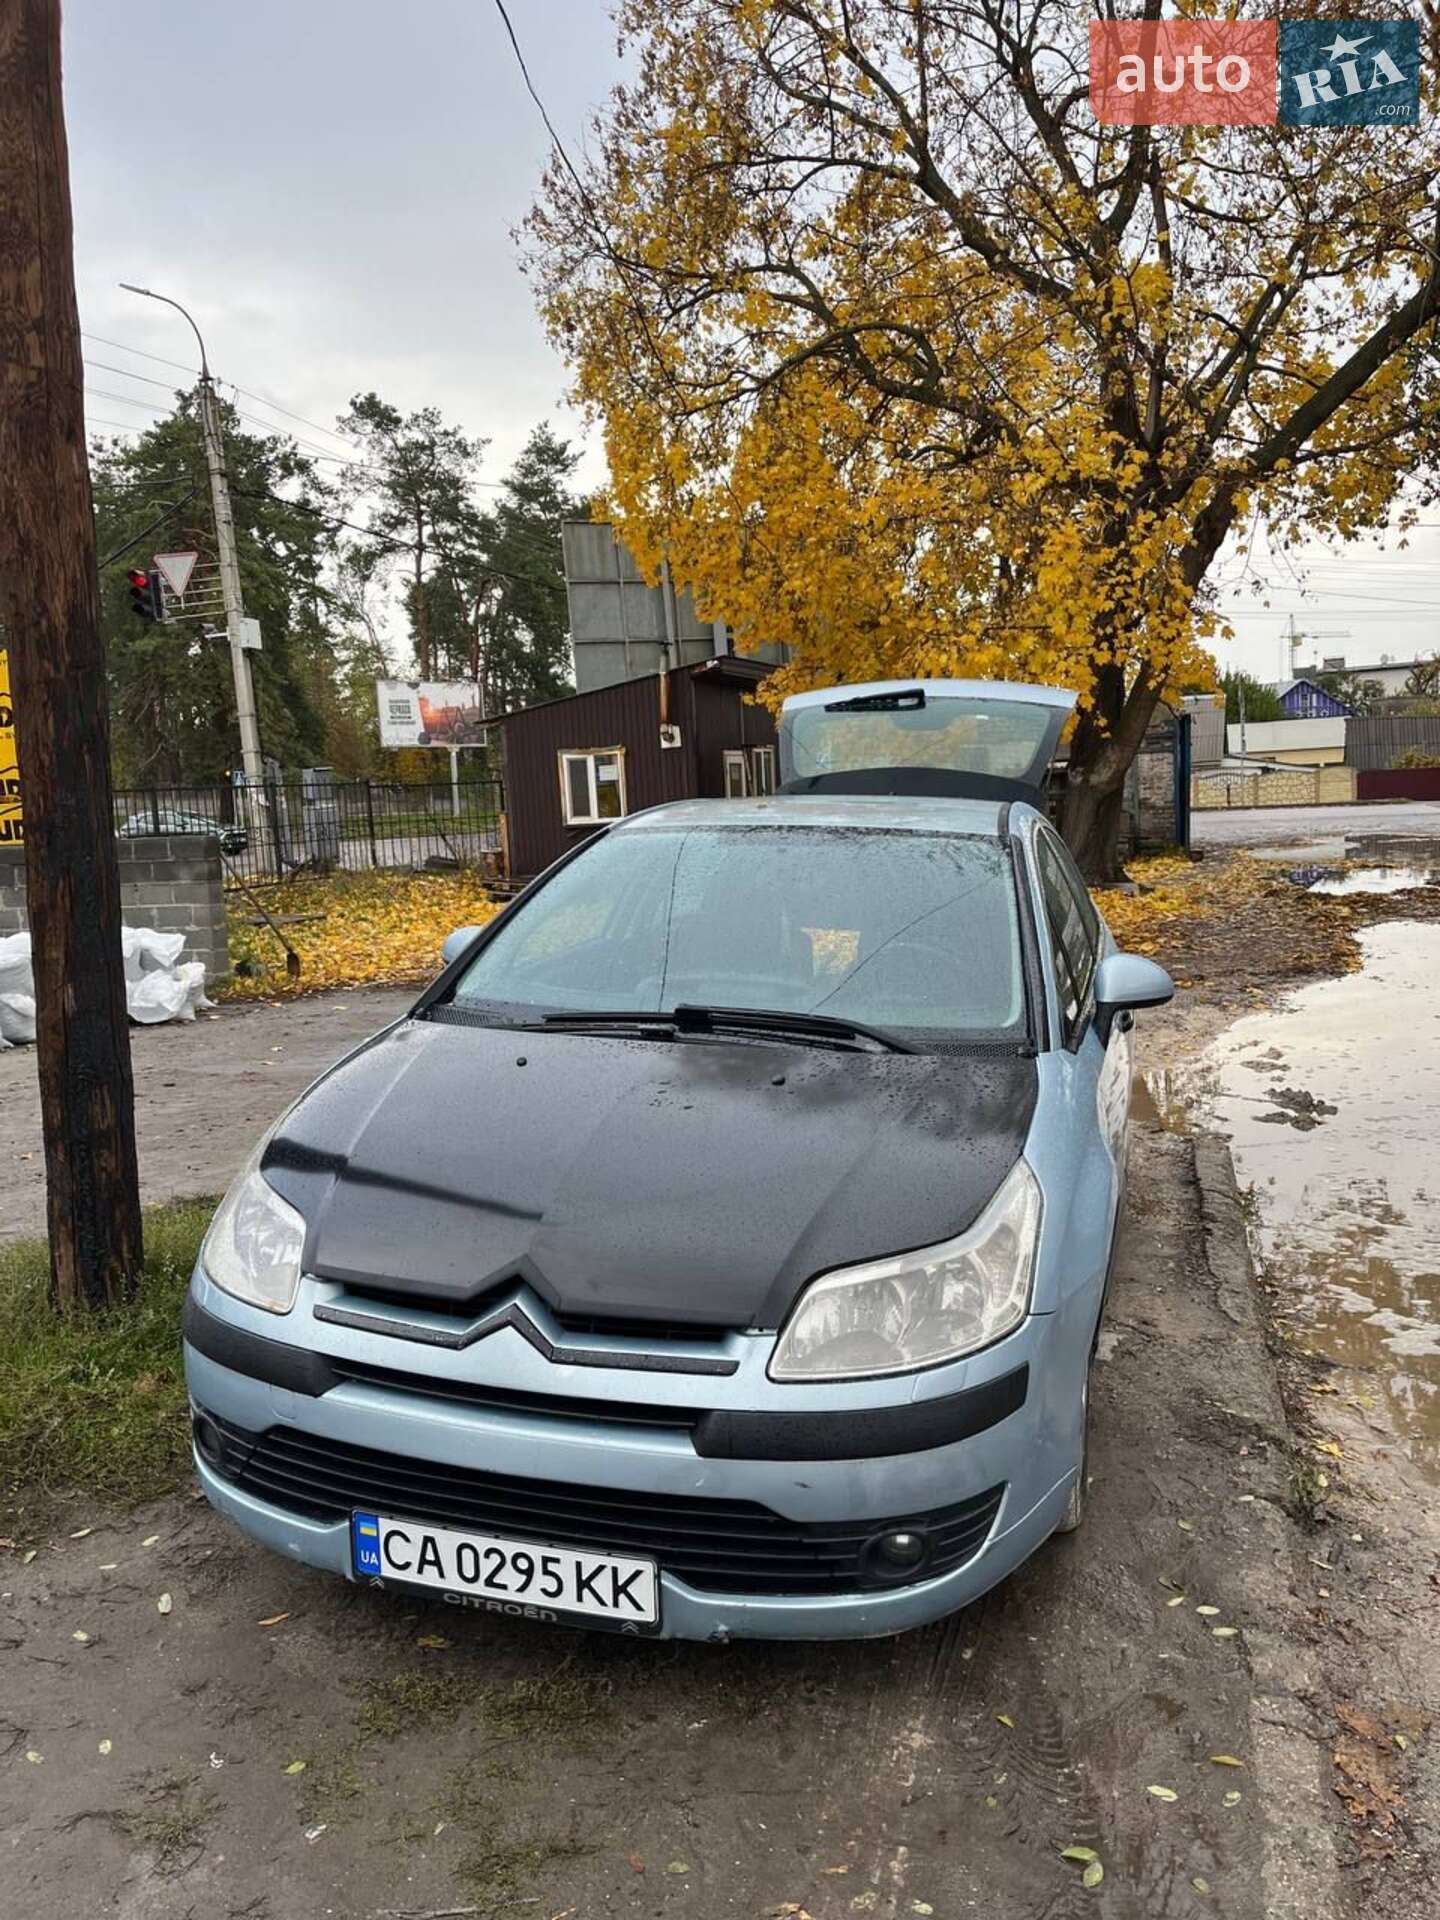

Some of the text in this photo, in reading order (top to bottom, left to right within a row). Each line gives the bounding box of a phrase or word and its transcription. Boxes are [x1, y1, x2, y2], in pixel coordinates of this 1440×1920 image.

[360, 1549, 379, 1565] UA
[383, 1529, 645, 1612] CA 0295 KK
